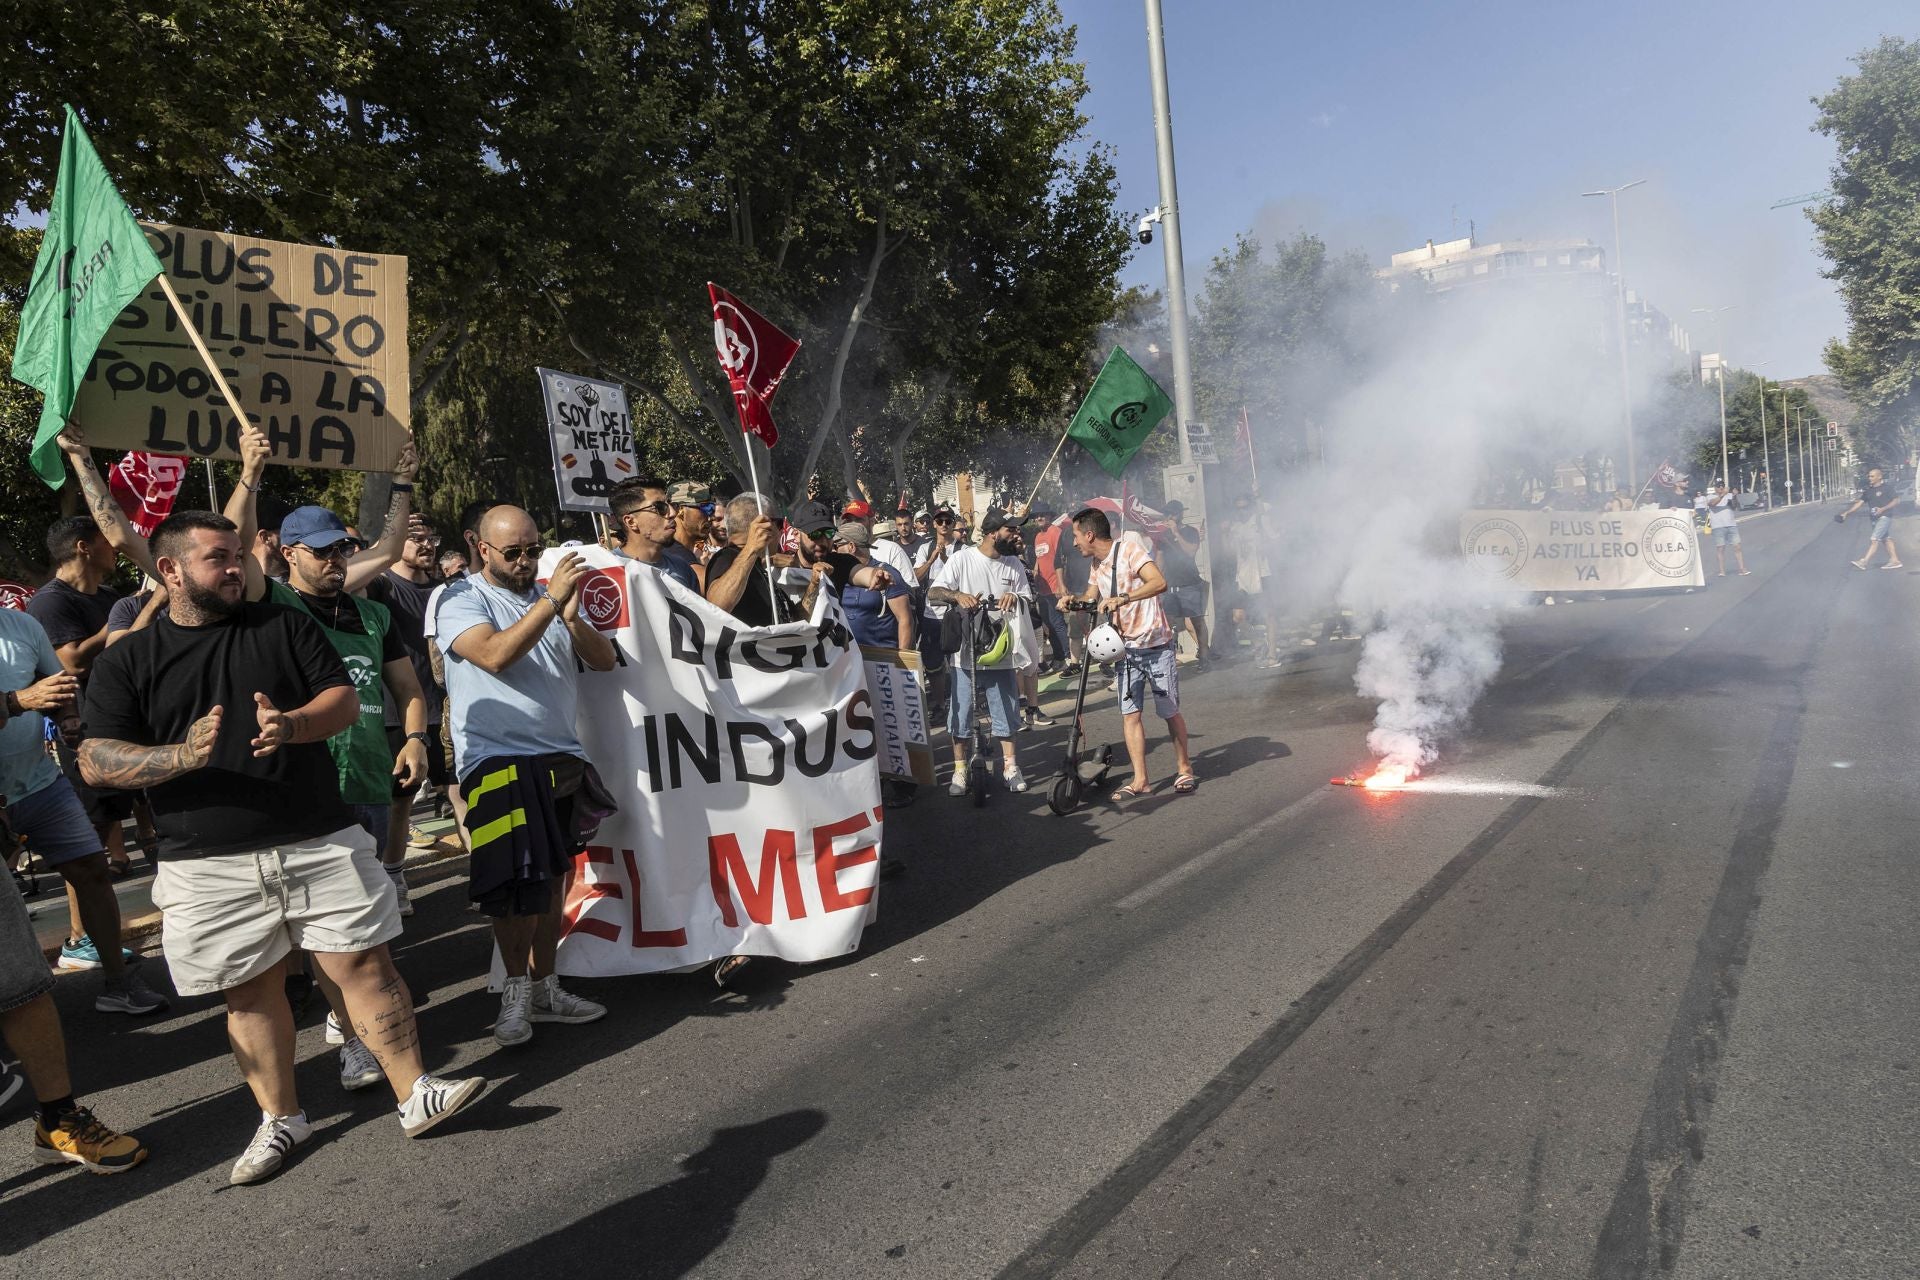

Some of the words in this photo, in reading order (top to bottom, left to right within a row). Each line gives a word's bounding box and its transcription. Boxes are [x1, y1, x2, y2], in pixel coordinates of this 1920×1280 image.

[314, 251, 379, 297] DE
[261, 371, 292, 405] A
[315, 370, 387, 417] LA
[145, 405, 356, 465] LUCHA
[557, 401, 591, 428] SOY
[600, 410, 632, 436] DEL
[571, 428, 632, 454] METAL
[1532, 541, 1640, 560] ASTILLERO
[1549, 521, 1595, 537] PLUS
[1600, 520, 1624, 536] DE
[1575, 565, 1601, 581] YA
[875, 662, 906, 777] ESPECIALES
[899, 670, 925, 744] PLUSES
[707, 805, 883, 928] ME
